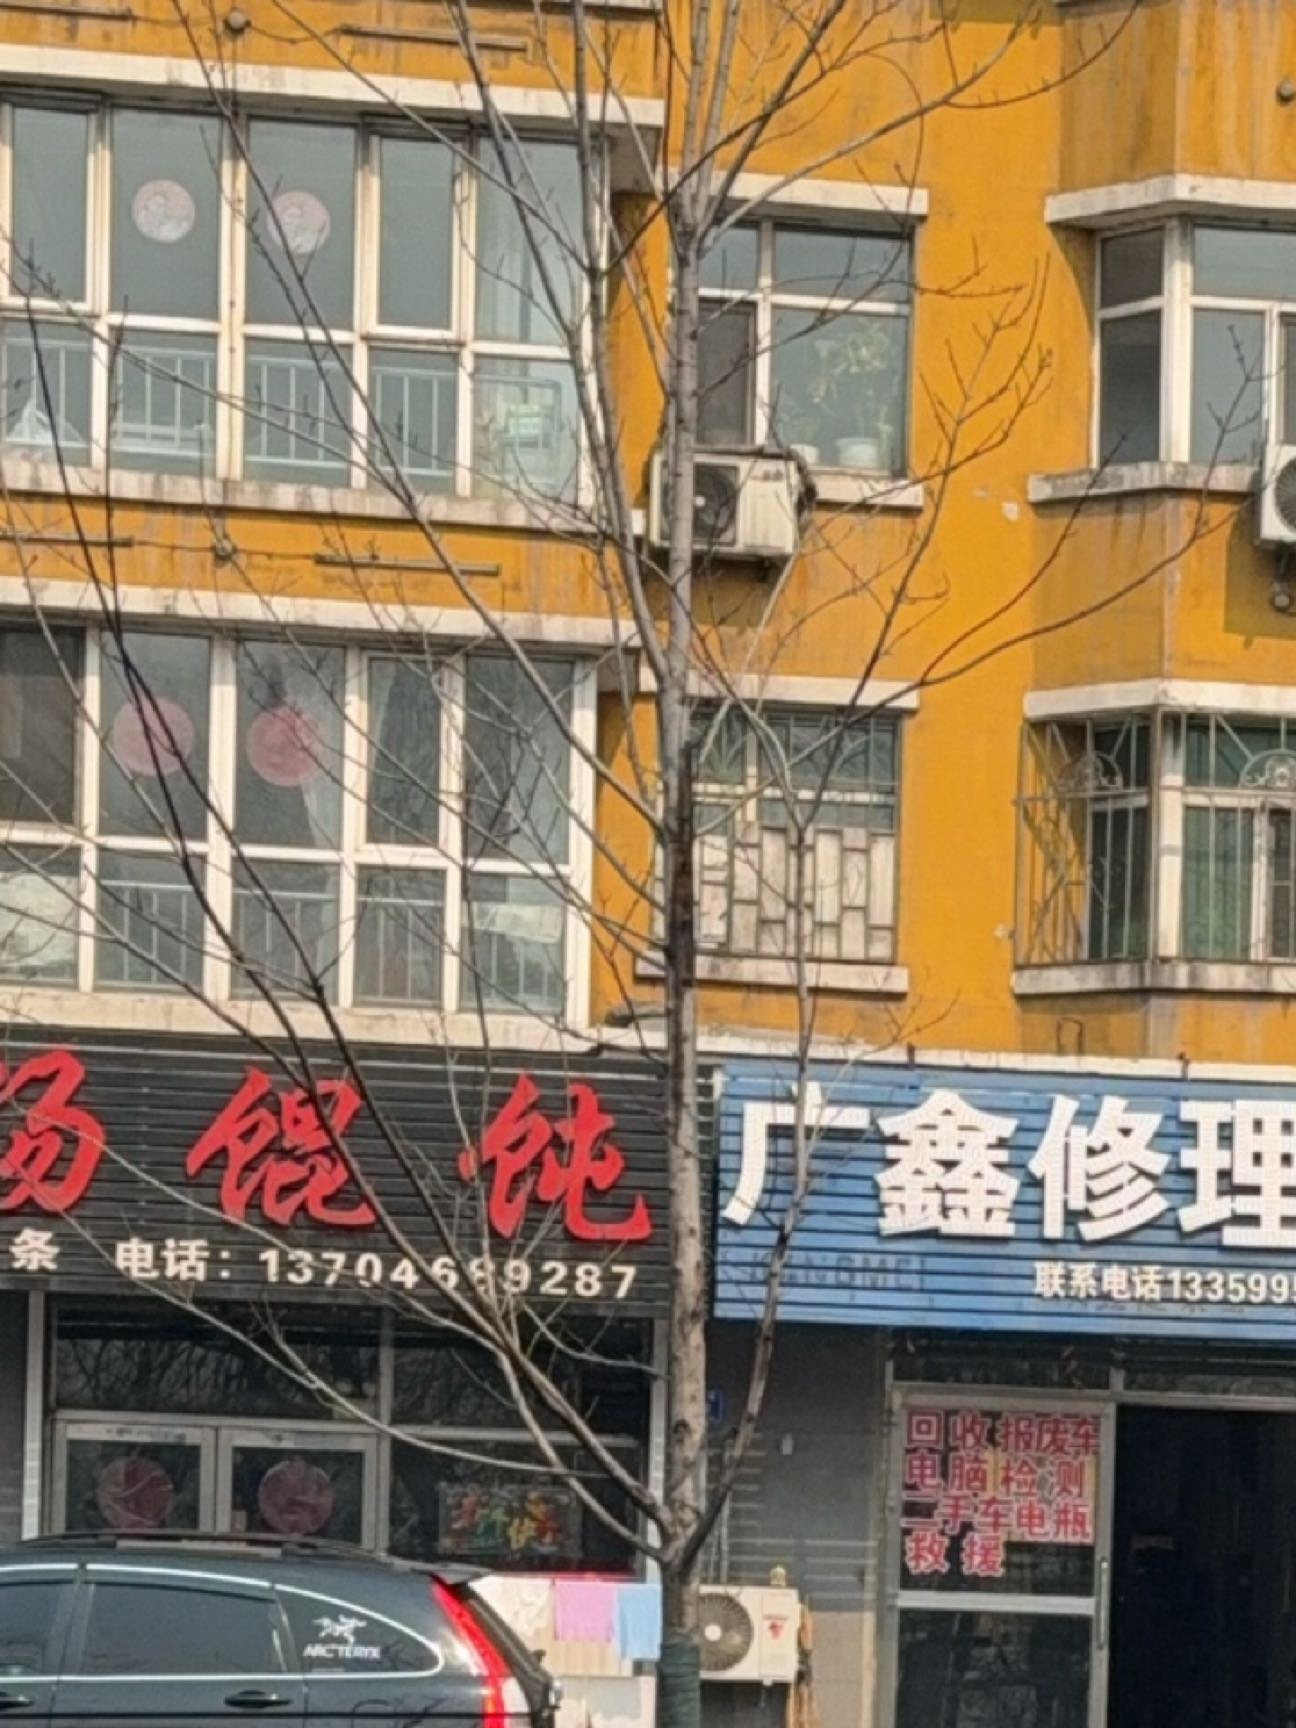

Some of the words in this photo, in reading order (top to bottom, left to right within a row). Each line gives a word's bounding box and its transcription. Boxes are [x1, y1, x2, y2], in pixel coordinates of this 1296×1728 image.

[905, 1409, 1103, 1457] 回收报废车
[903, 1451, 1088, 1498] 电脑检测
